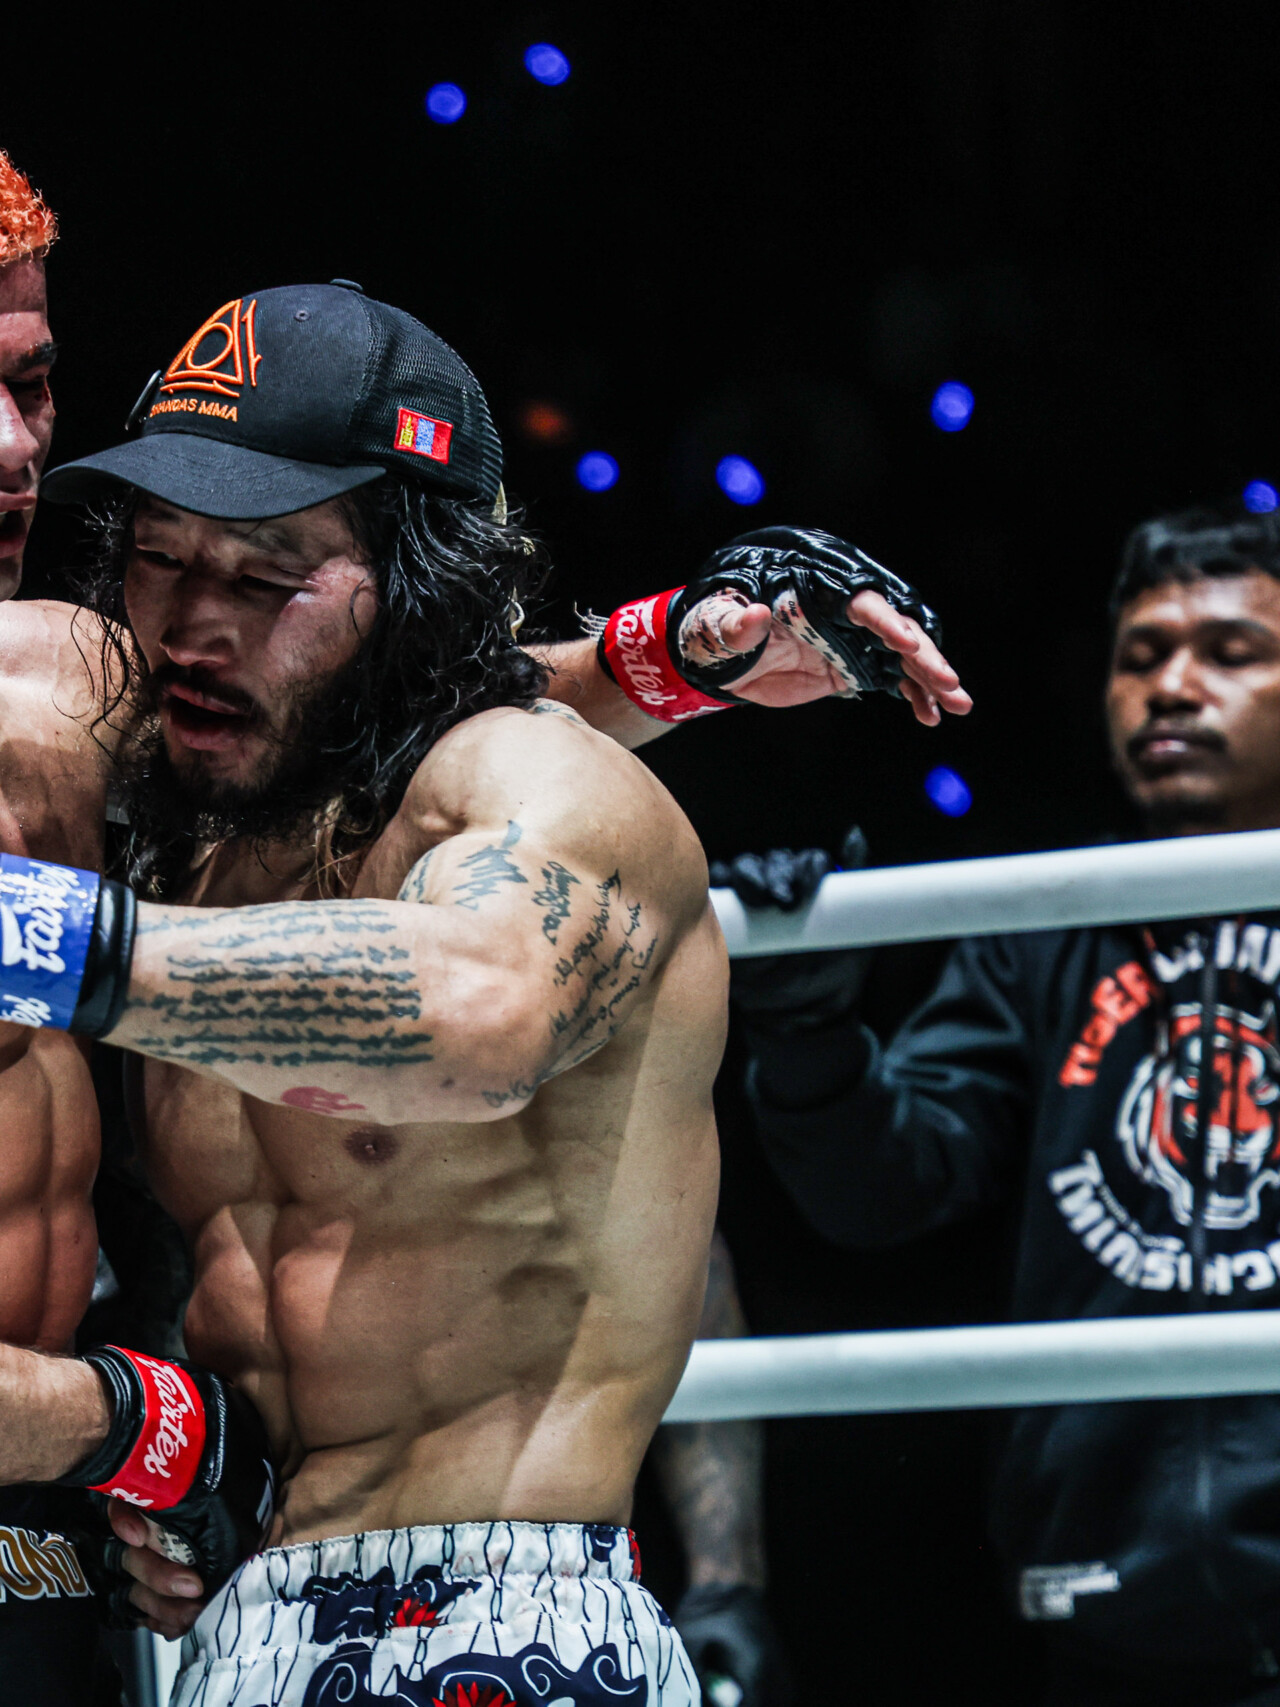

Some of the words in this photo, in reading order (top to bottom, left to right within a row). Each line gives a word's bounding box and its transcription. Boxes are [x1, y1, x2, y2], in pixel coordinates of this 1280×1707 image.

[198, 400, 238, 422] MMA
[615, 596, 677, 706] Fairtex
[0, 861, 80, 974] Fairtex
[1059, 960, 1161, 1088] TIGER
[135, 1356, 197, 1478] Fairtex
